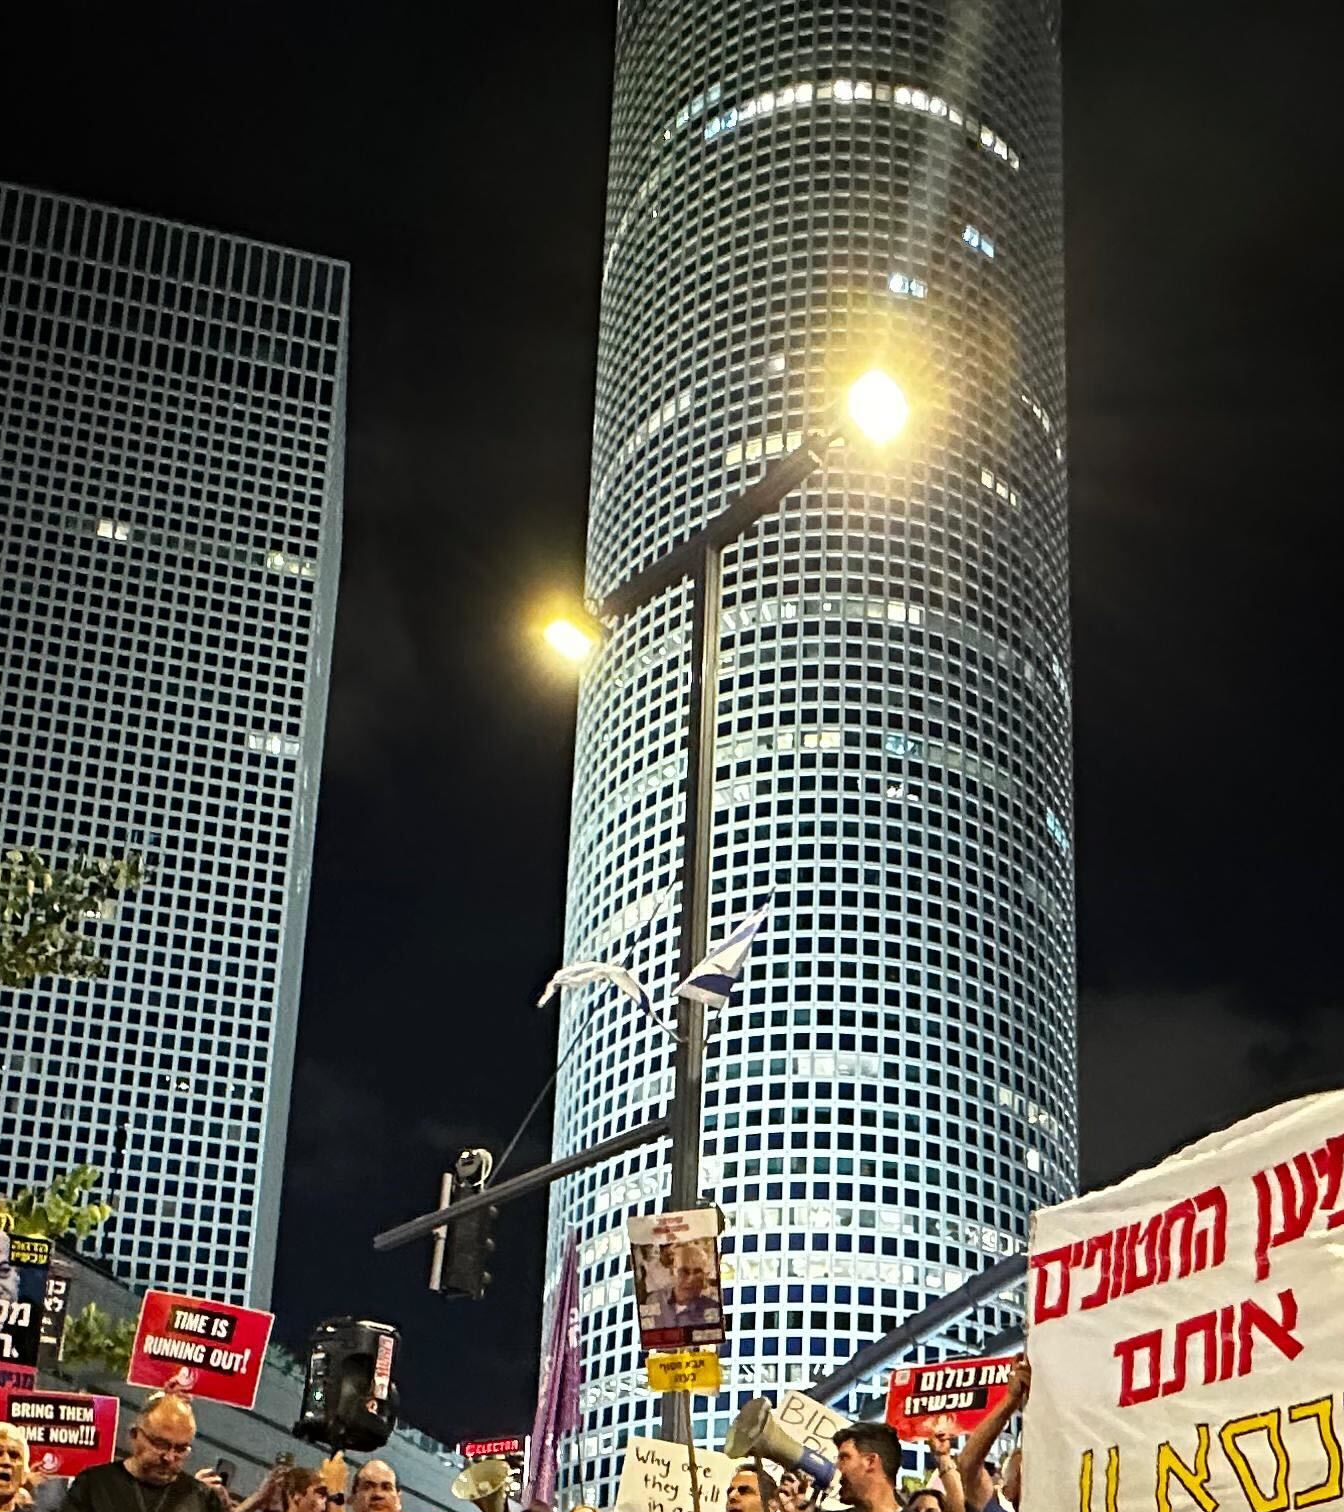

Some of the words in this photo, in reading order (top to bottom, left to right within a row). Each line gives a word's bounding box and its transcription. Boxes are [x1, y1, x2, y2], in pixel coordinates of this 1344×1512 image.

[1030, 1185, 1228, 1326] החטופים
[174, 1310, 210, 1334] TIME
[210, 1317, 230, 1338] IS
[143, 1334, 207, 1364] RUNNING
[209, 1348, 251, 1375] OUT!
[1113, 1288, 1306, 1408] אותם
[978, 1363, 1012, 1387] את
[11, 1401, 54, 1420] BRING
[59, 1404, 94, 1423] THEM
[904, 1391, 974, 1416] עכשיו!
[22, 1424, 45, 1442] OME
[48, 1426, 96, 1446] NOW!!!
[635, 1446, 671, 1478] Why
[644, 1474, 679, 1501] they
